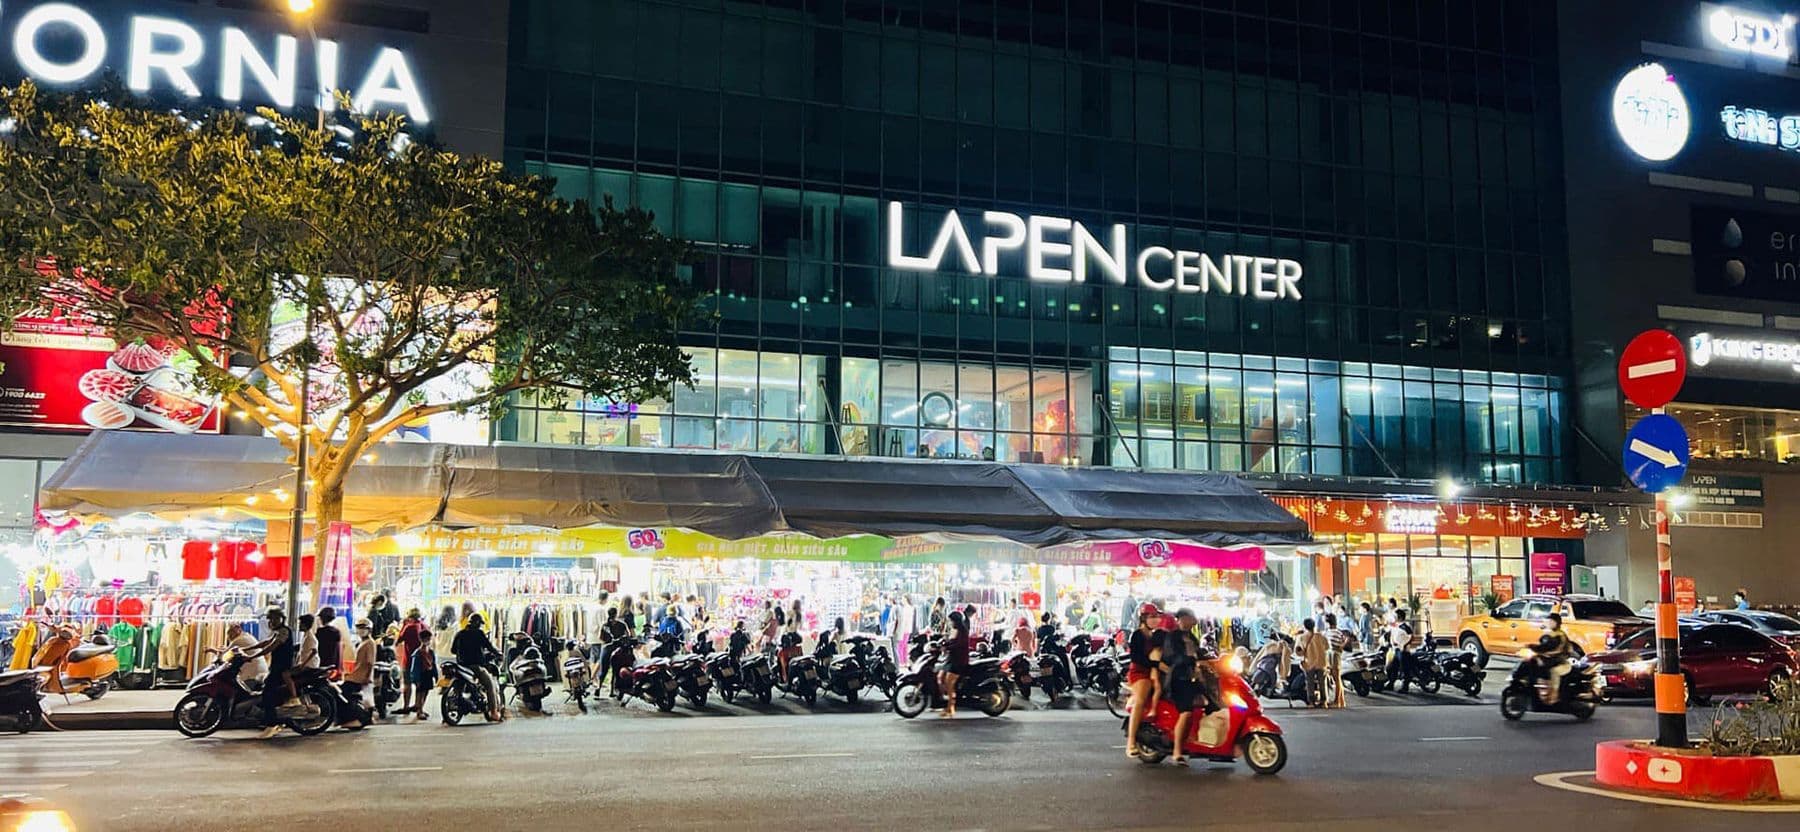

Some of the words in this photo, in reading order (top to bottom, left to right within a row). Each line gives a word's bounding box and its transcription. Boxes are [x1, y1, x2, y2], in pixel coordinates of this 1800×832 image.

[888, 200, 1126, 284] LAPEN
[1138, 246, 1303, 300] CENTER
[1693, 475, 1717, 484] LAPEN
